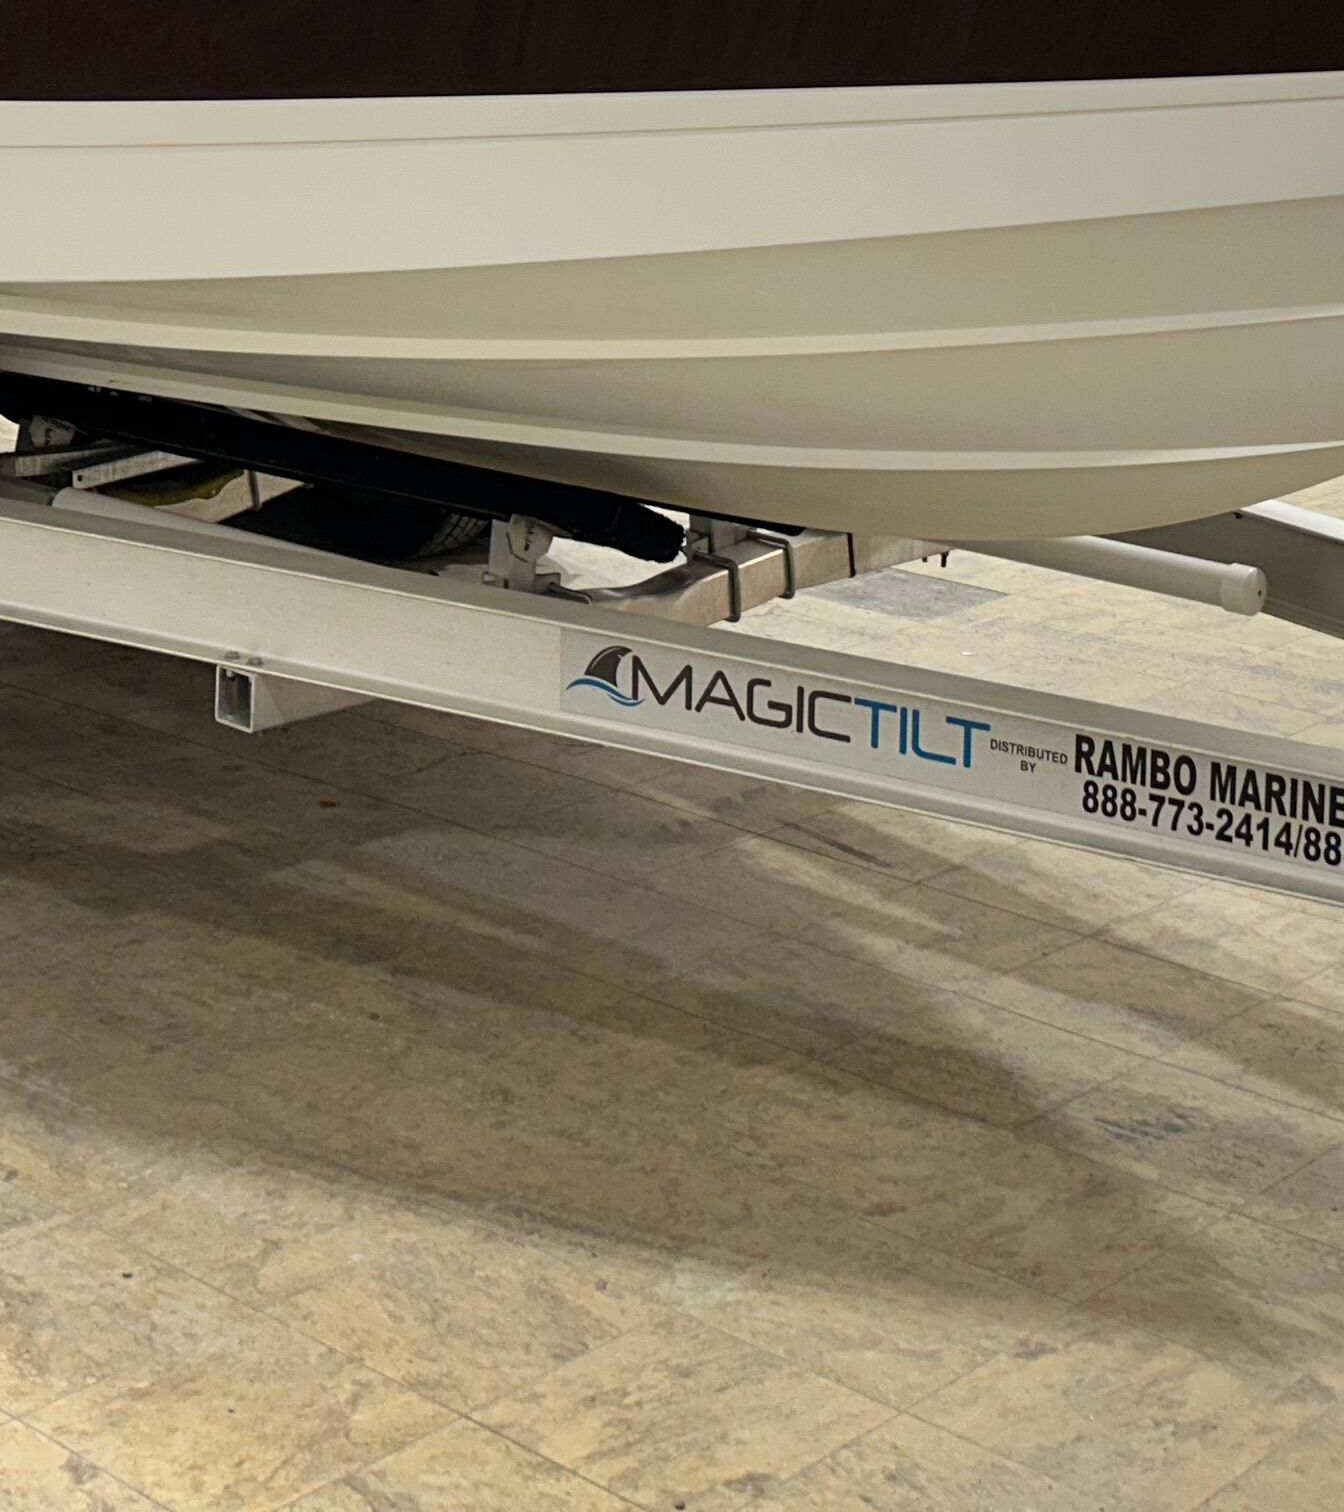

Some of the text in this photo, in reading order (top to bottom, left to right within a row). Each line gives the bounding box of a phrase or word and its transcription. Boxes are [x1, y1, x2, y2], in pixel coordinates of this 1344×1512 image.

[990, 738, 1068, 765] DISTRIBUTED
[1074, 733, 1197, 795] RAMBO
[1020, 759, 1036, 773] BY
